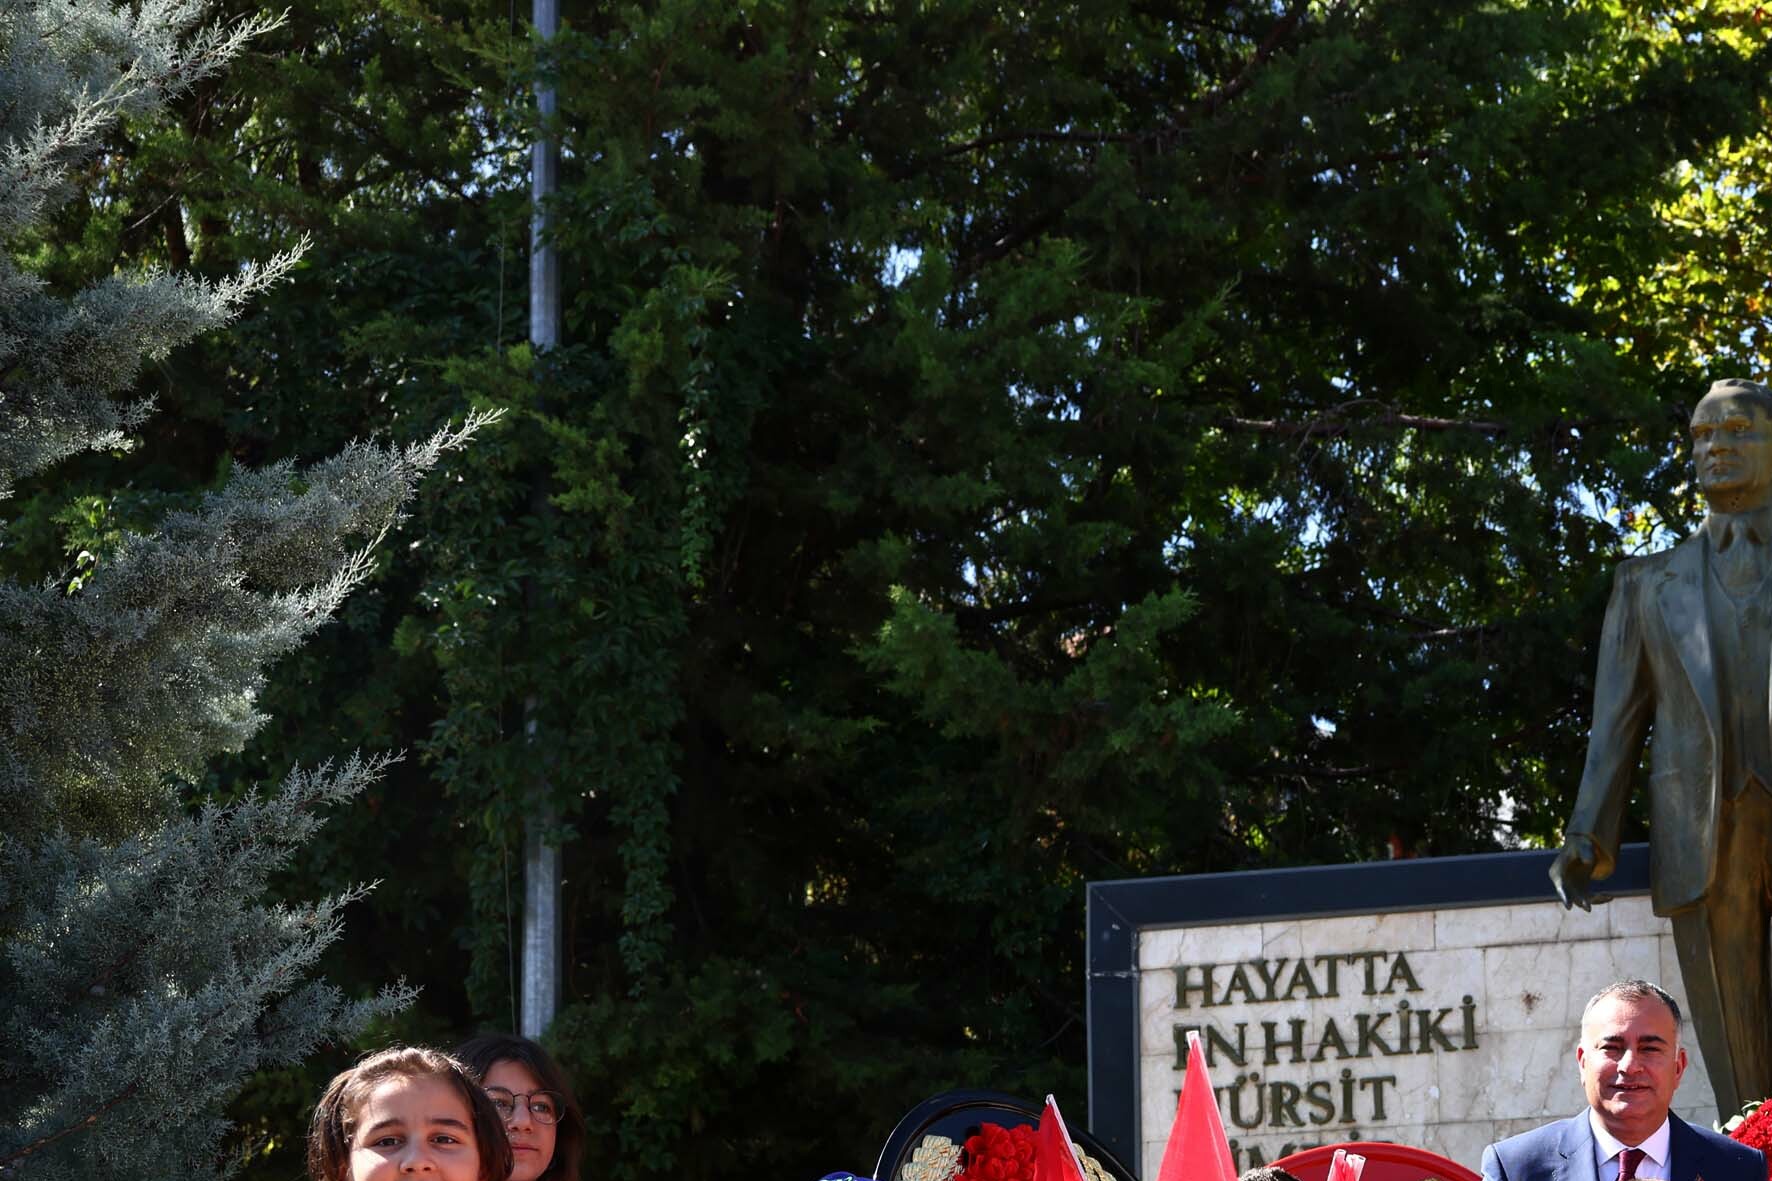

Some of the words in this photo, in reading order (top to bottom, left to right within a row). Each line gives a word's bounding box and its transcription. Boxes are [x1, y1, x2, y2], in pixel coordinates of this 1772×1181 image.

[1172, 951, 1424, 1009] HAYATTA
[1260, 994, 1479, 1066] HAKİKİ
[1172, 1068, 1396, 1130] ÜRSİT
